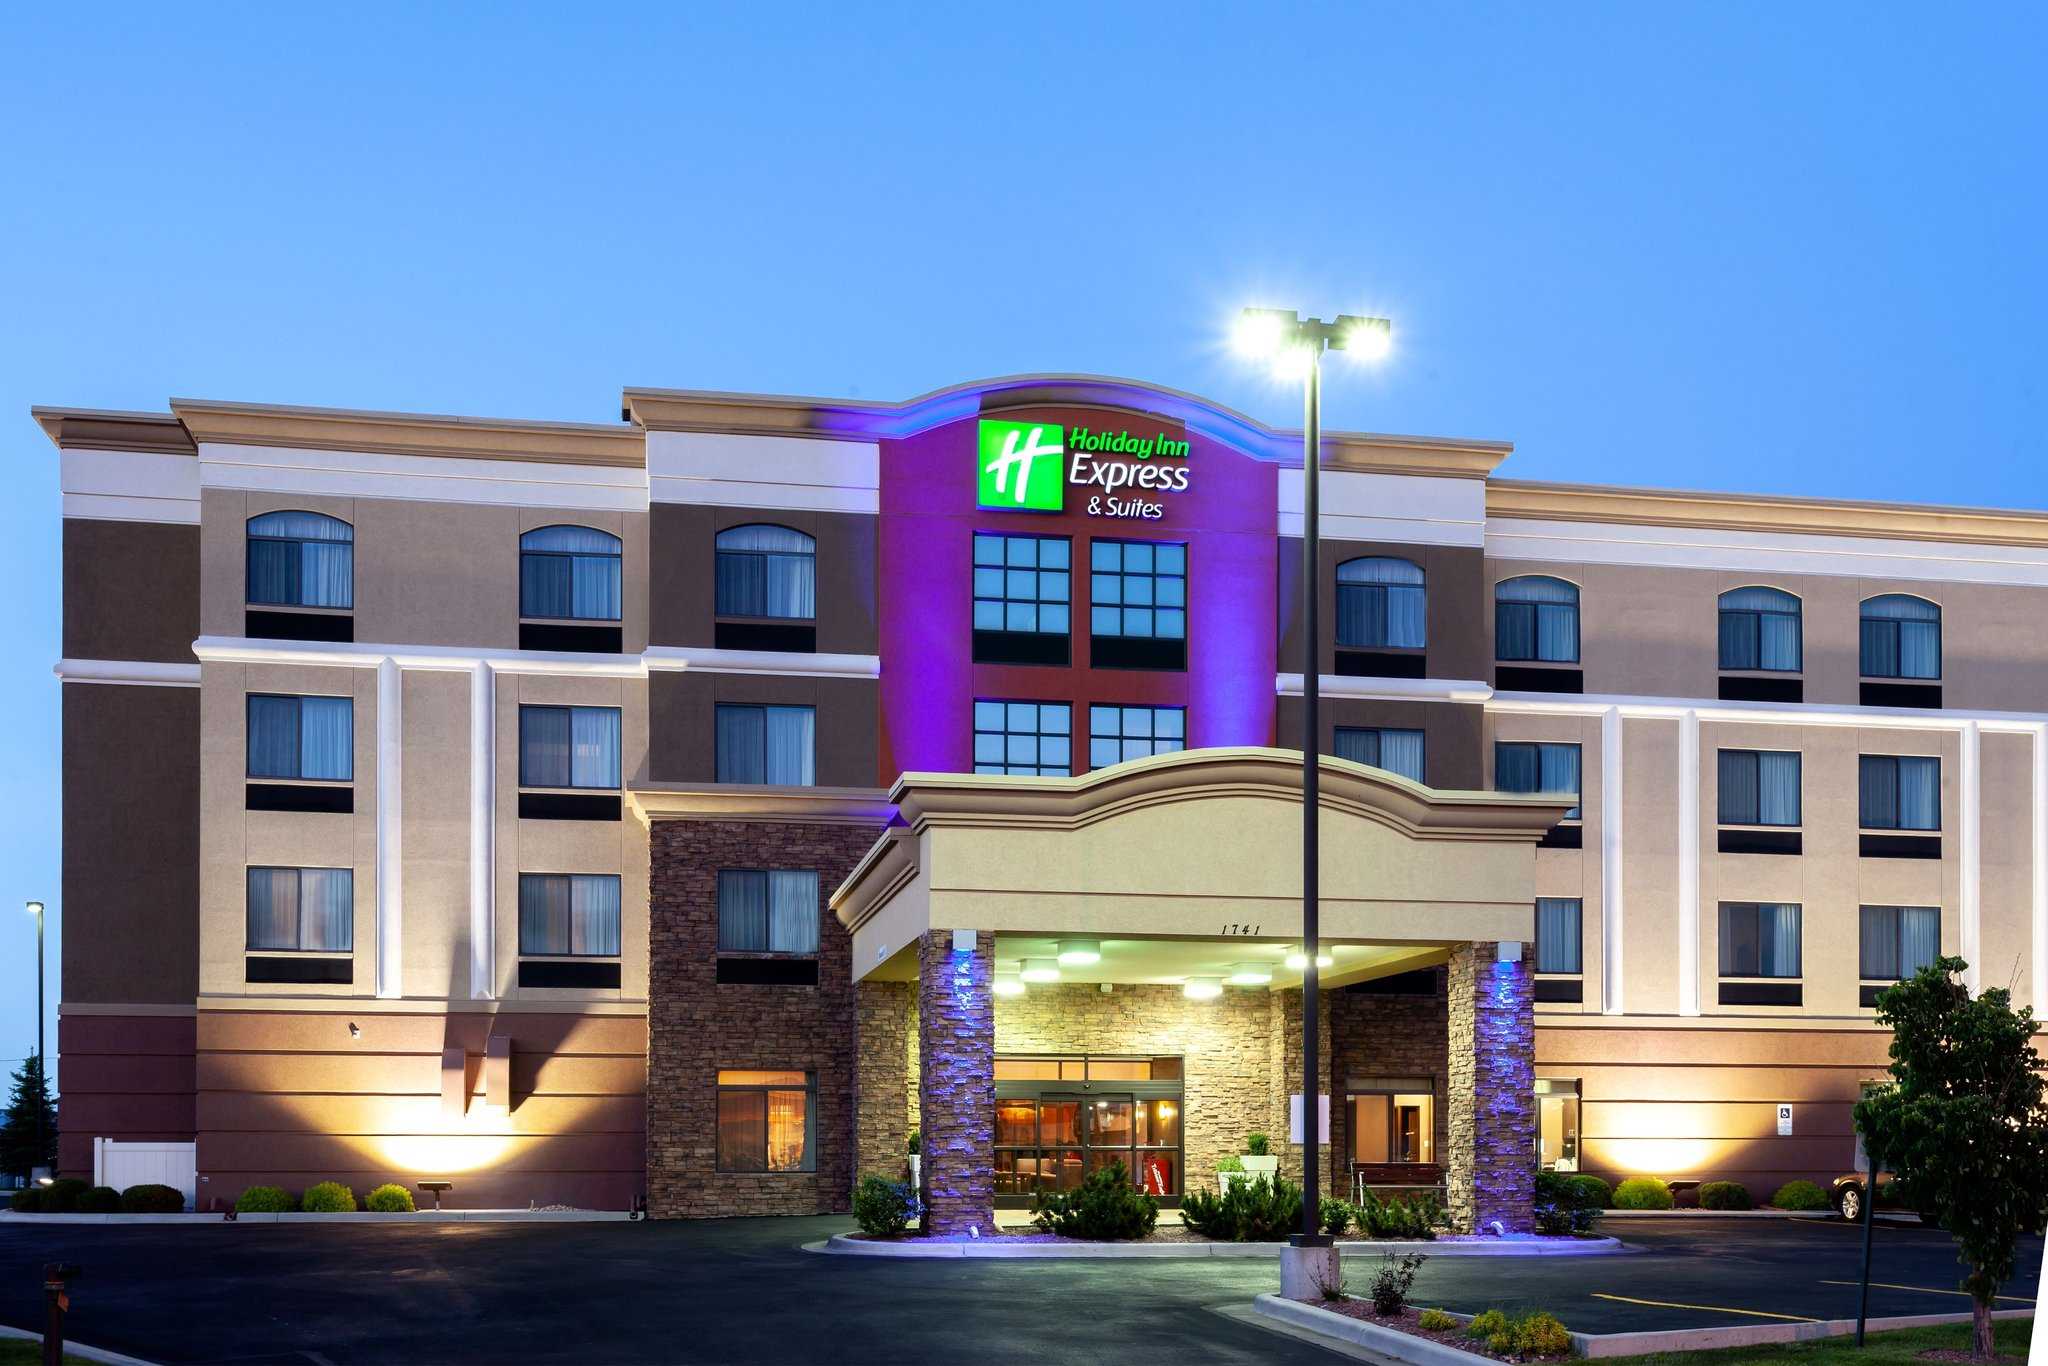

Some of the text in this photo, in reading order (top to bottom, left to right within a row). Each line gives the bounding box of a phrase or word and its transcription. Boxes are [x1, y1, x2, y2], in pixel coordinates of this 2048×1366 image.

[1069, 427, 1190, 458] Holiday Inn
[1069, 453, 1190, 494] Express
[1087, 496, 1162, 519] & Suites
[1221, 924, 1260, 935] 1741
